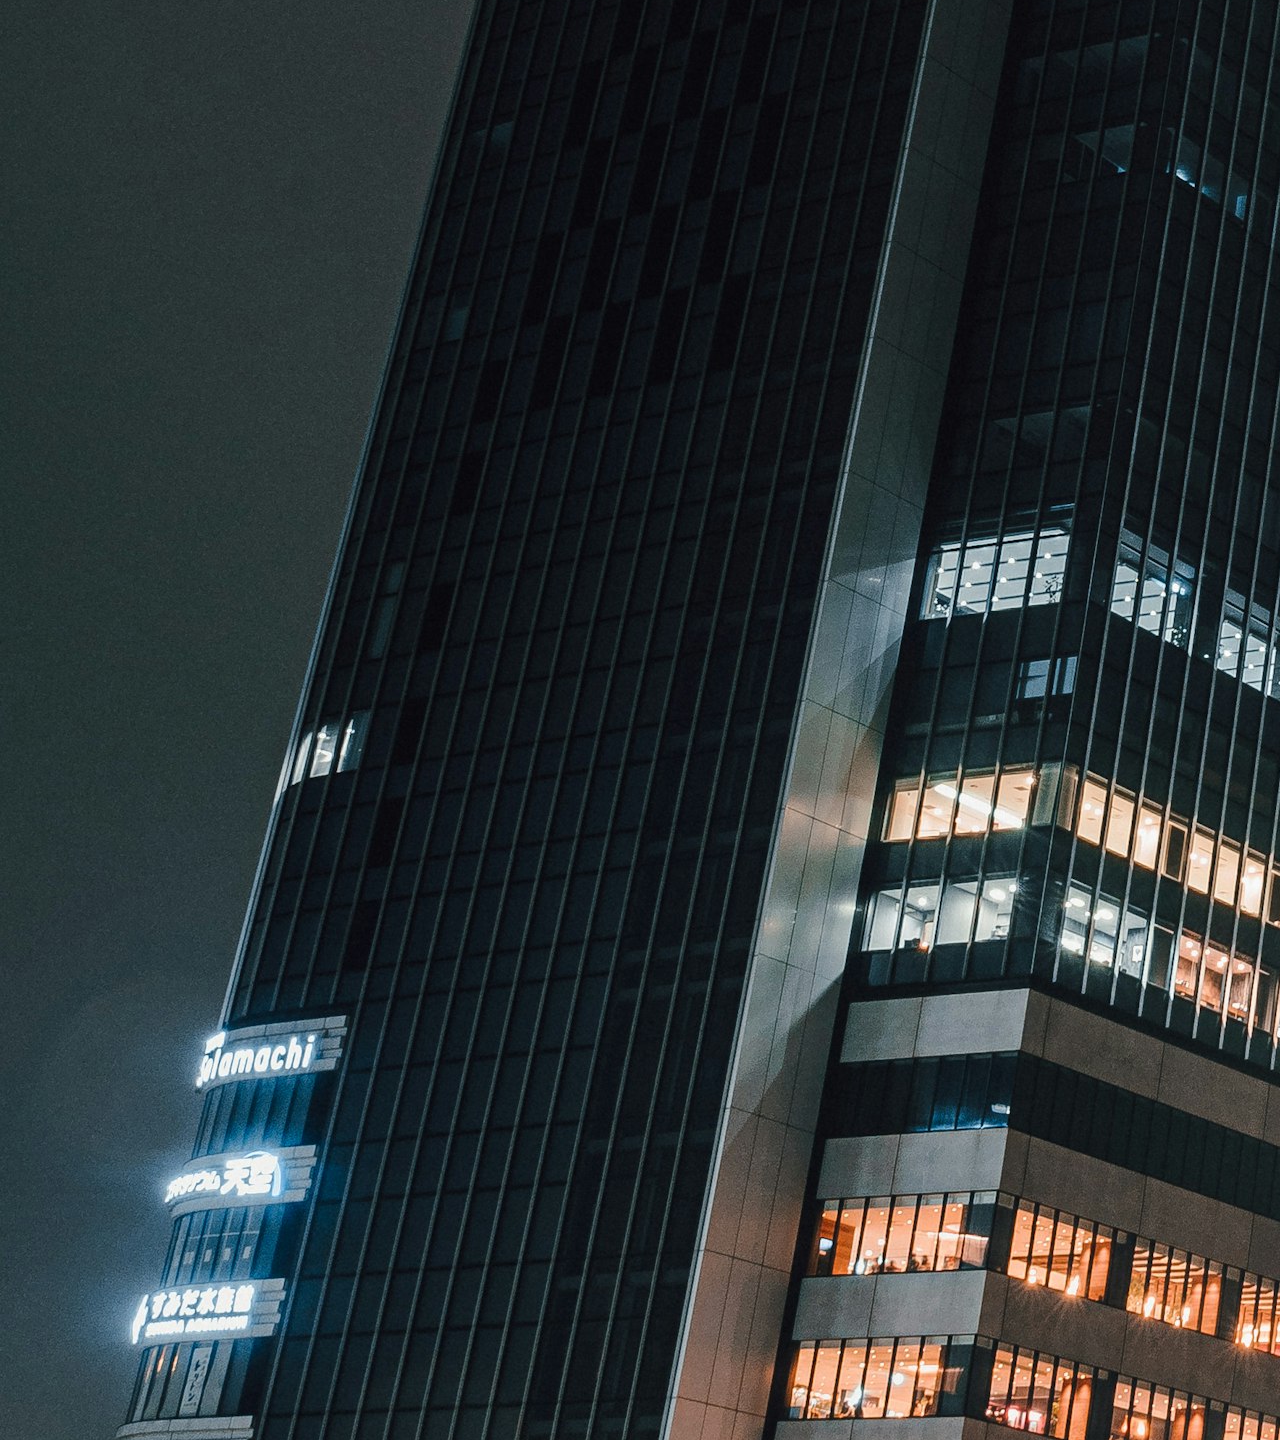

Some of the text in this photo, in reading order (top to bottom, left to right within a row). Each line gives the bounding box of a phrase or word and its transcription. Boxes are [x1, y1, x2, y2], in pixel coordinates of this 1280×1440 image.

[151, 1284, 255, 1320] すみだ水族館
